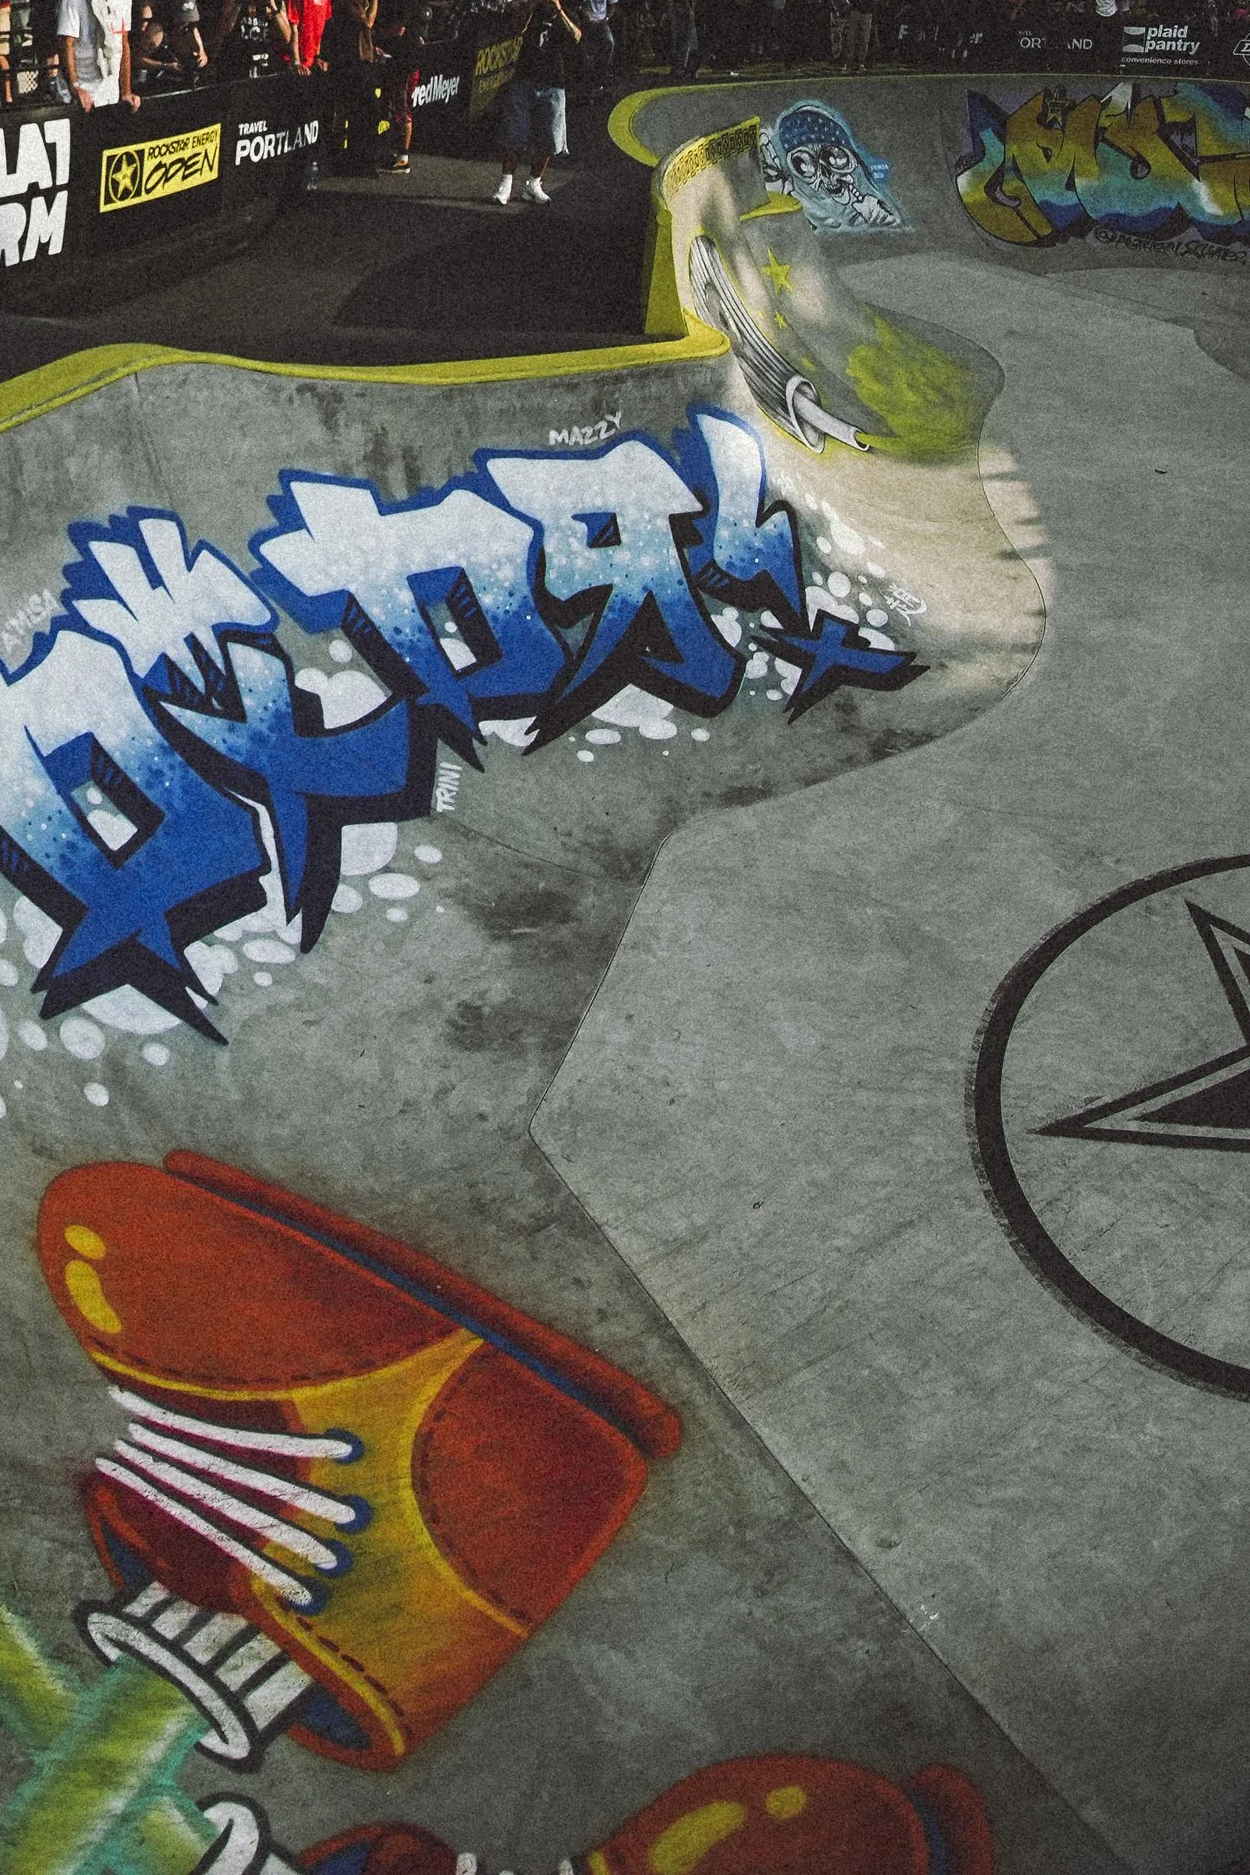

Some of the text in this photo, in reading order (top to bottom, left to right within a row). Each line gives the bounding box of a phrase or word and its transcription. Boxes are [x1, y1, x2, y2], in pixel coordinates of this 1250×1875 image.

[1144, 39, 1201, 55] pantry
[1147, 25, 1189, 39] plaid
[235, 120, 319, 166] PORTLAND
[238, 120, 268, 136] TRAVEL
[147, 136, 191, 161] ROCKSTAR
[144, 145, 218, 194] OPEN
[549, 410, 622, 446] MAZZY
[436, 761, 462, 813] TRINI
